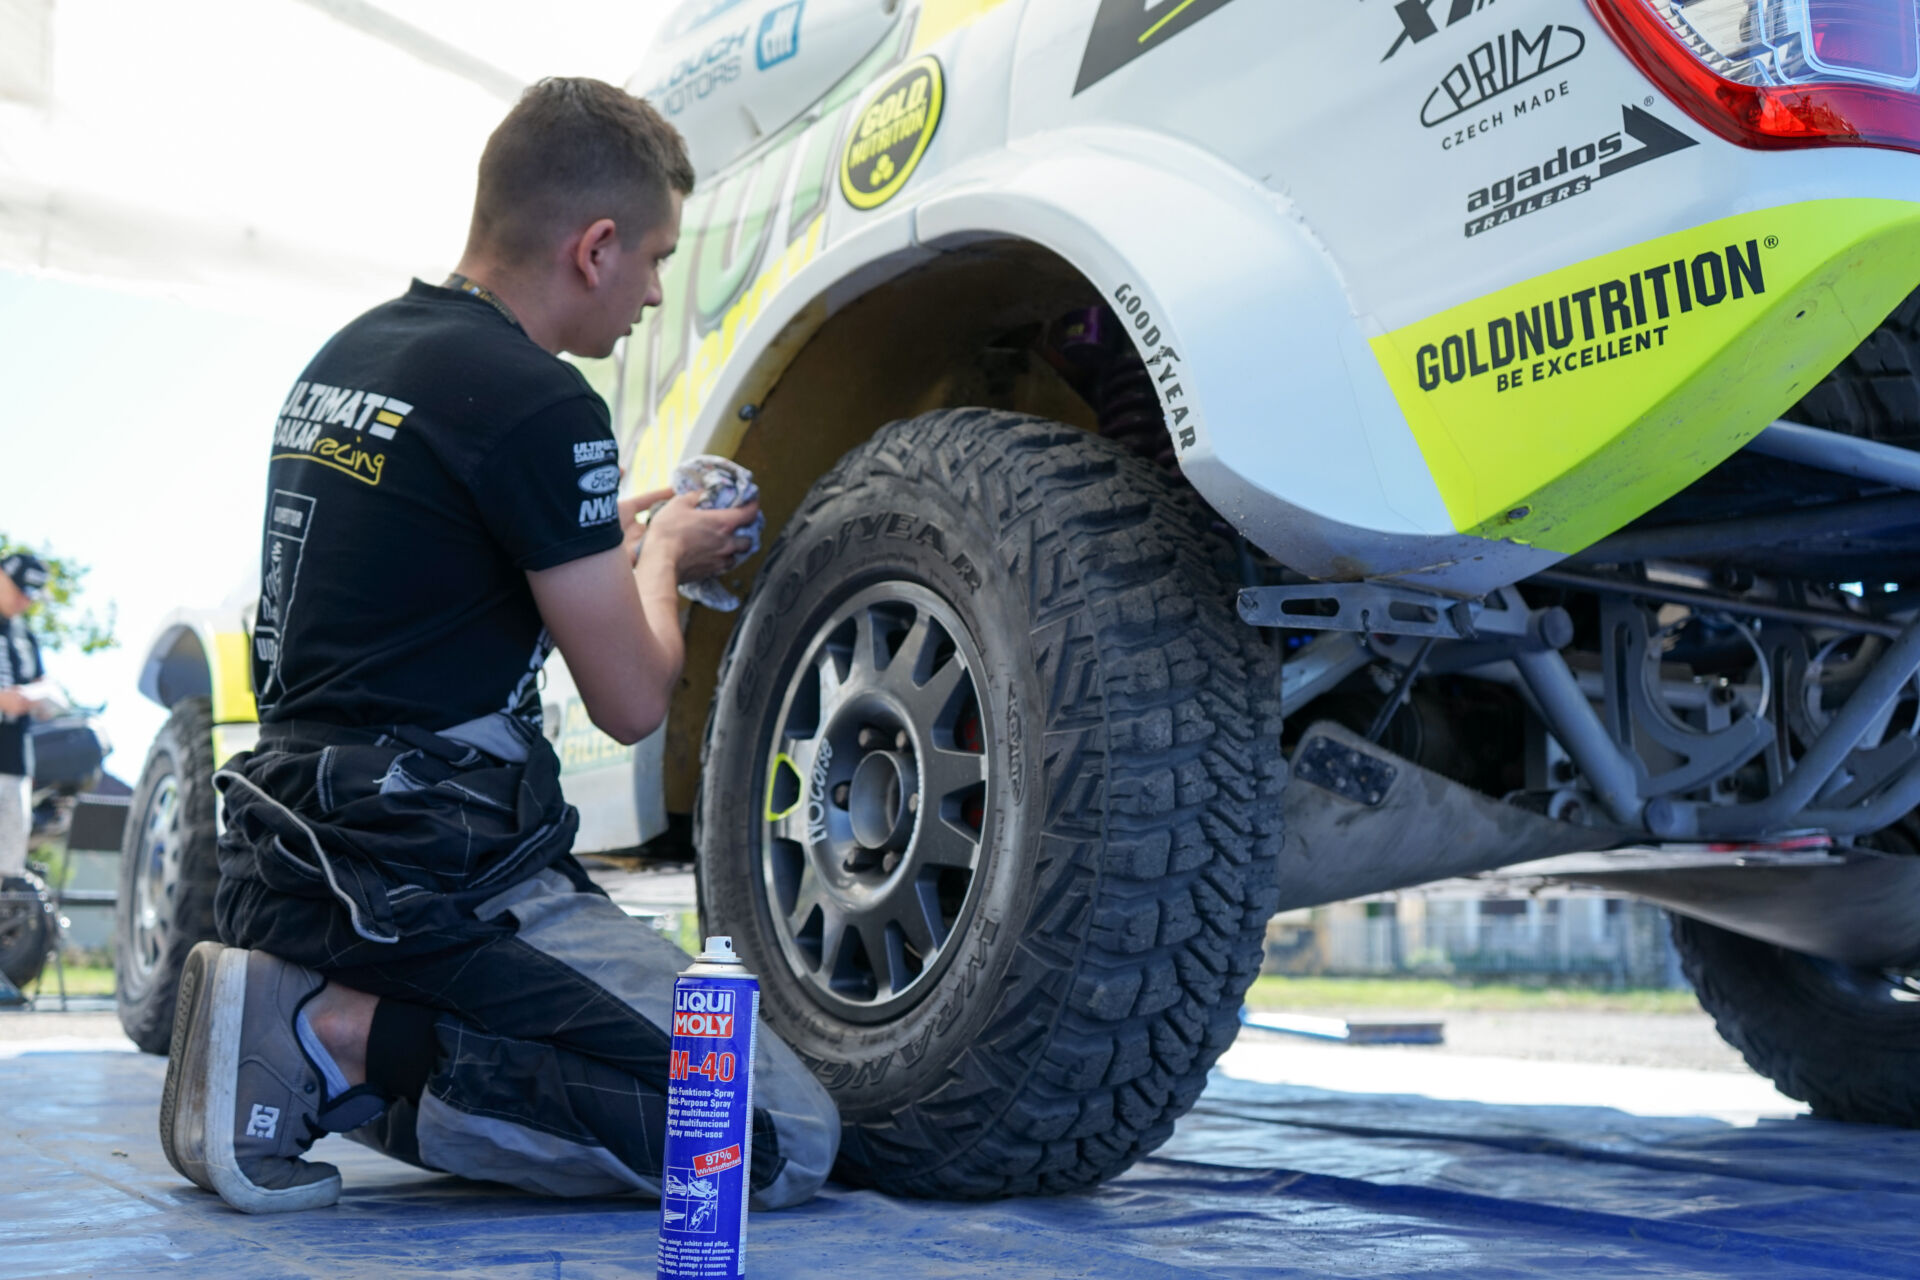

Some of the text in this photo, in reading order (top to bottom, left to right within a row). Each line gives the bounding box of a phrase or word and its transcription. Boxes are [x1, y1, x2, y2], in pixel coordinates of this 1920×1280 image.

[1438, 25, 1556, 113] PRIM
[849, 97, 928, 168] NUTRITION
[860, 75, 929, 139] GOLD
[1442, 81, 1570, 150] CZECH MADE
[1467, 131, 1622, 213] agados
[1466, 177, 1590, 236] TRAILERS
[1114, 283, 1197, 450] GOODYEAR
[1497, 325, 1669, 393] BE EXCELLENT
[674, 1014, 733, 1036] MOLY
[676, 991, 731, 1013] LIQUI
[793, 915, 1001, 1090] WRANG
[684, 1128, 723, 1138] multi-usos
[710, 1099, 732, 1110] Spray
[705, 1150, 732, 1166] 97%
